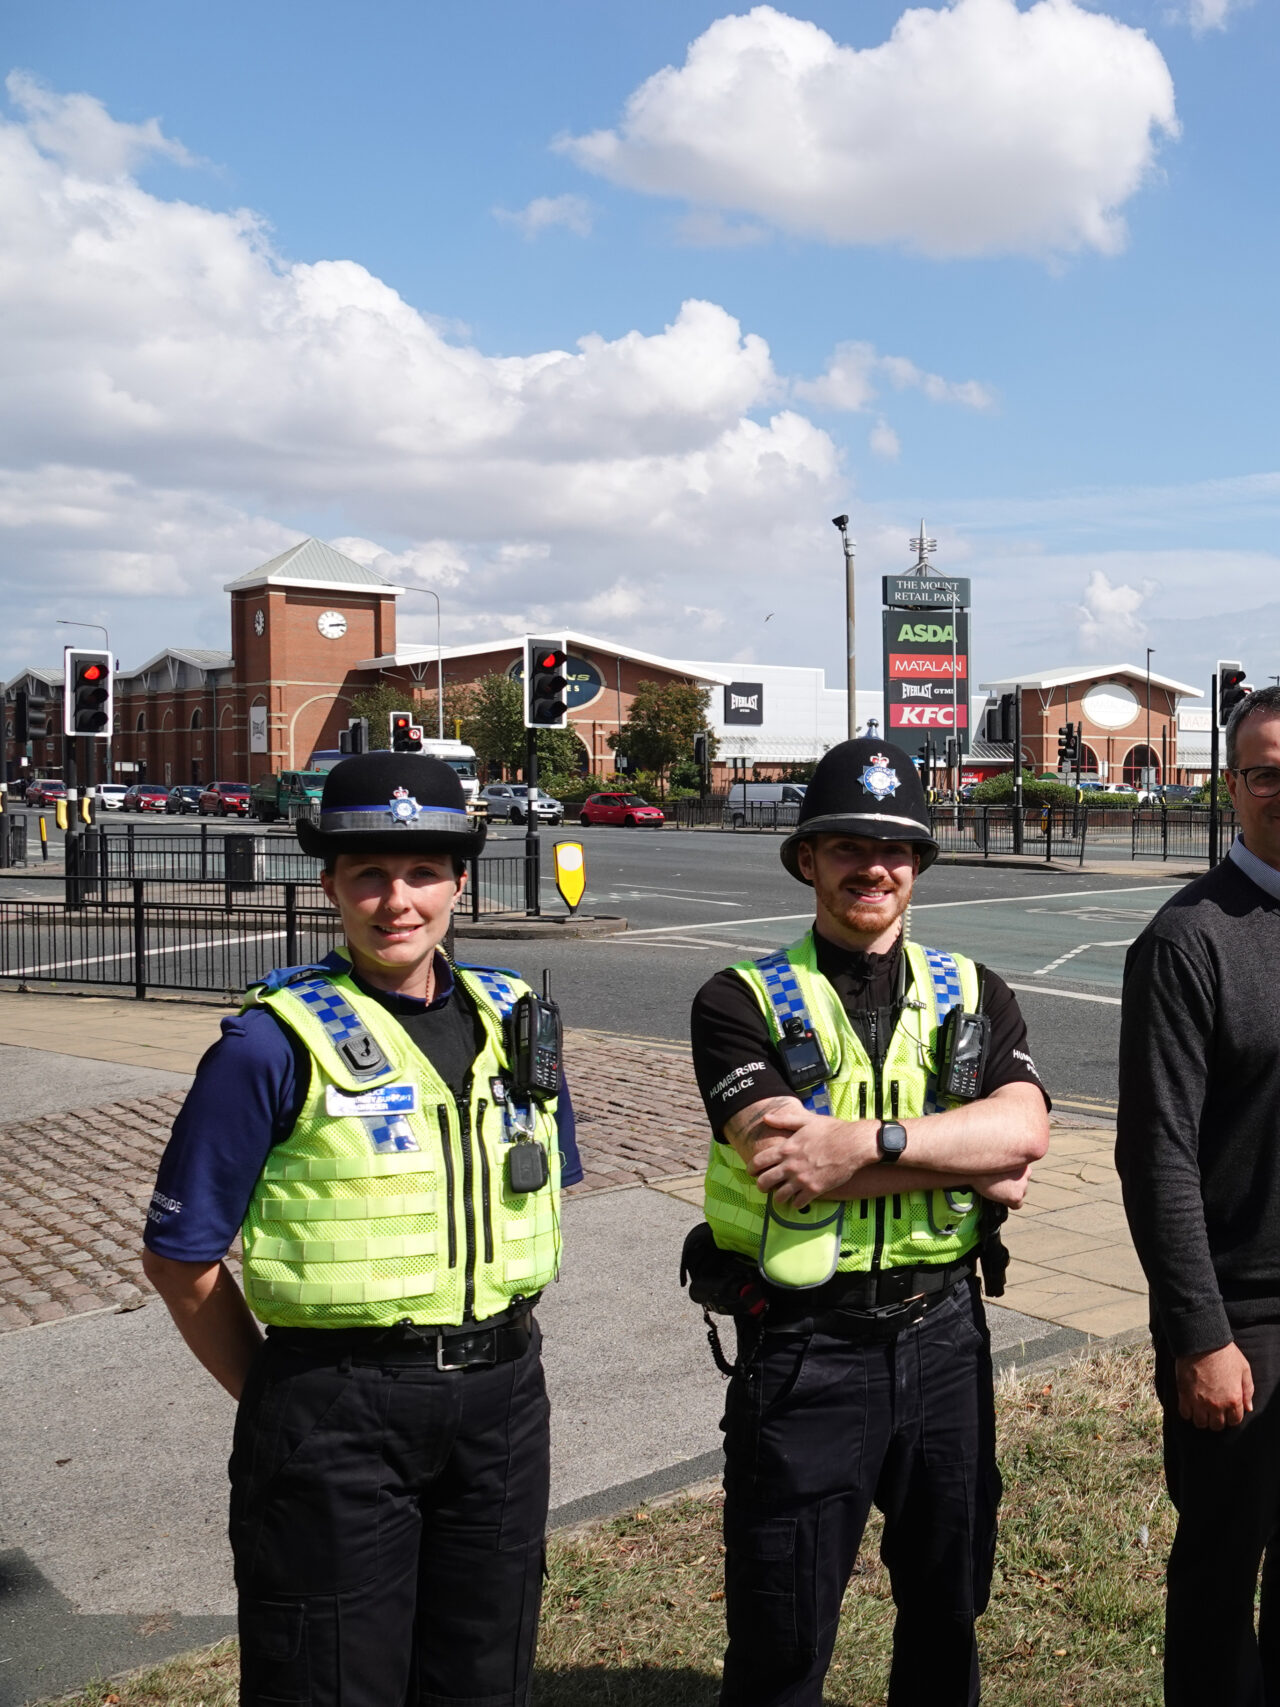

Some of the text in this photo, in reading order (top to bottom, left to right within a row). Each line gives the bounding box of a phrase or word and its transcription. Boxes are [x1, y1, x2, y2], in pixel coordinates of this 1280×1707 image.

[896, 580, 959, 591] THE MOUNT
[895, 592, 961, 602] RETAIL PARK
[897, 624, 958, 643] ASDA
[895, 660, 962, 672] MATALAN
[902, 683, 933, 699] EVERLAST
[731, 693, 758, 710] EVERLAST
[899, 706, 958, 725] KFC
[710, 1061, 766, 1099] HUMBERSIDE
[722, 1077, 754, 1101] POLICE
[153, 1190, 183, 1214] BERSIDE
